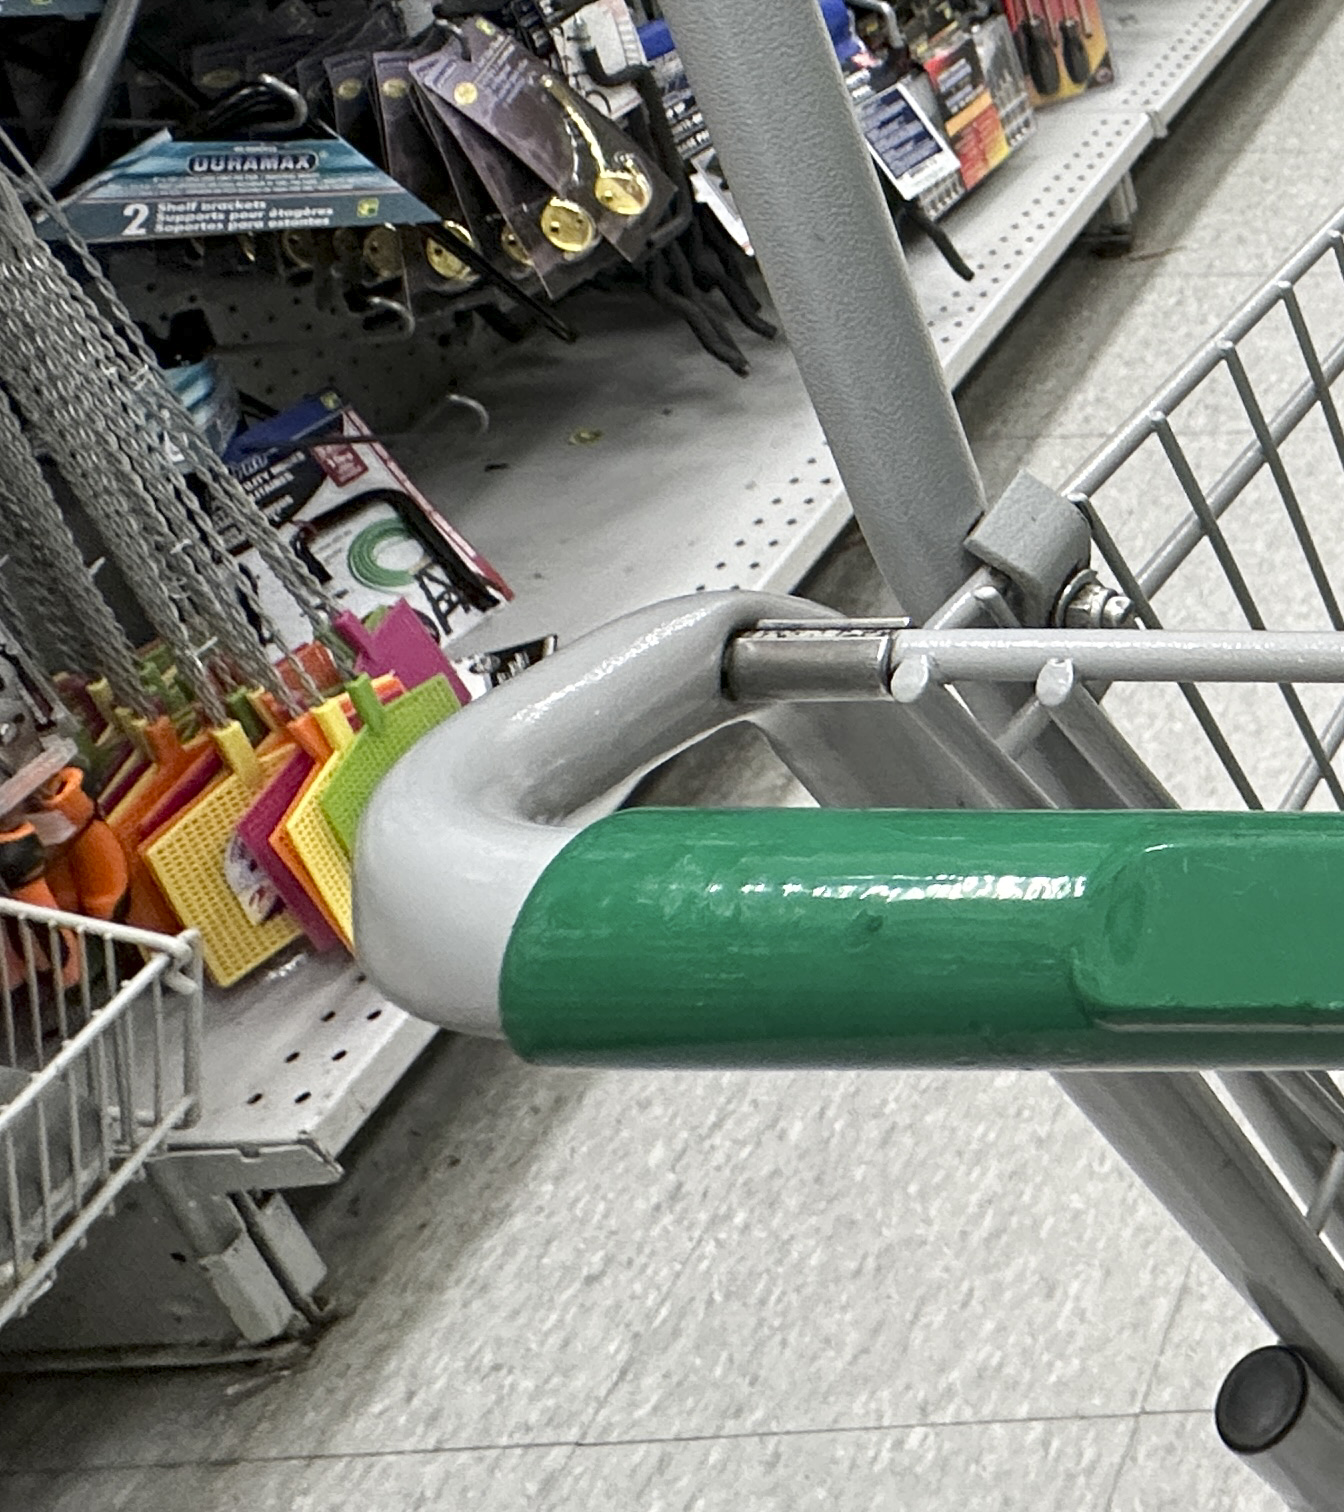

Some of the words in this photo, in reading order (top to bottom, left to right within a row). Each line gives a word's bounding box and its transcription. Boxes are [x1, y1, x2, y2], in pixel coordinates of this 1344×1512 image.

[193, 155, 310, 172] DURAMAX
[157, 201, 197, 212] Shelf
[201, 199, 267, 211] brackets
[121, 203, 150, 236] 2
[157, 210, 224, 224] Supports
[229, 209, 265, 222] pour
